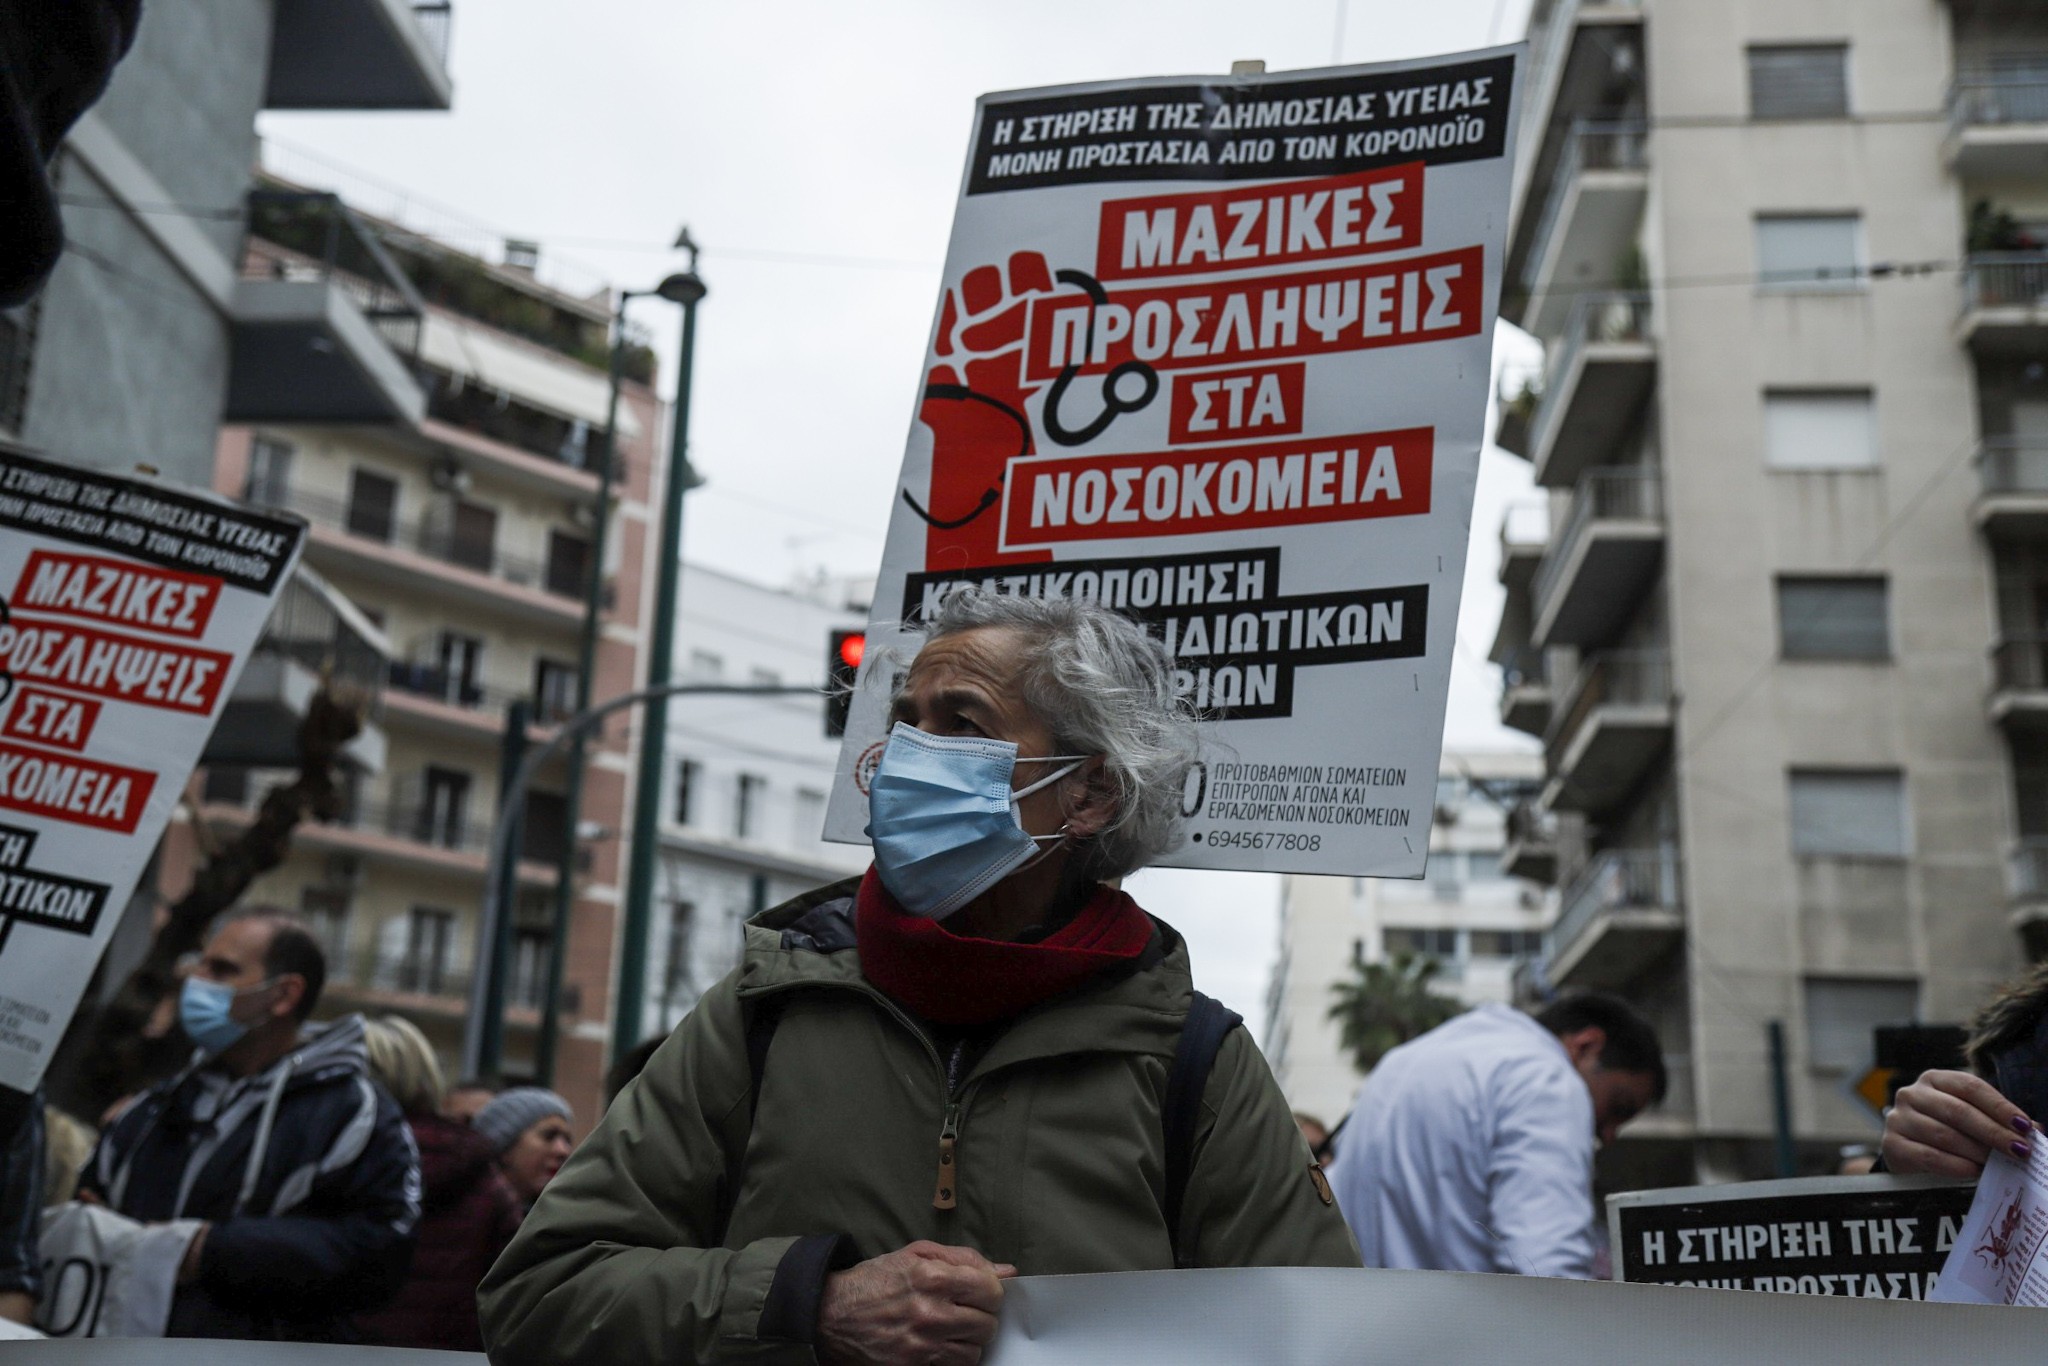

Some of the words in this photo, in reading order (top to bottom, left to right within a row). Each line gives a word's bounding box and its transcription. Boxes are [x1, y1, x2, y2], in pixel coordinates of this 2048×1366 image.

[992, 117, 1014, 145] Η
[1021, 104, 1138, 143] ΣΤΗΡΙΞΗ
[1146, 103, 1203, 131] ΤΗΣ
[1210, 94, 1375, 131] ΔΗΜΟΣΙΑΣ
[1384, 77, 1494, 117] ΥΓΕΙΑΣ
[987, 150, 1061, 178] ΜΟΝΗ
[1067, 140, 1210, 170] ΠΡΟΣΤΑΣΙΑ
[1217, 138, 1276, 165] ΑΠΟ
[1283, 134, 1338, 162] ΤΟΝ
[1344, 116, 1485, 159] ΚΟΡΟΝΟΪΟ
[1121, 179, 1405, 270] ΜΑΖΙΚΕΣ
[1049, 263, 1462, 369] ΠΡΟΣΛΗΨΕΙΣ
[1187, 373, 1286, 432] ΣΤΑ
[1029, 445, 1402, 529] ΝΟΣΟΚΟΜΕΙΑ
[216, 518, 287, 556] ΥΓΕΙΑΣ
[26, 560, 209, 631] ΜΑΖΙΚΕΣ
[1164, 600, 1404, 658] ΙΔΙΩΤΙΚΩΝ
[14, 694, 84, 743] ΣΤΑ
[1212, 783, 1289, 803] ΕΠΙΤΡΟΠΩΝ
[1292, 786, 1338, 804] ΑΓΩΝΑ
[1342, 788, 1365, 805] ΚΑΙ
[1214, 763, 1322, 784] ΠΡΩΤΟΒΑΘΜΙΩΝ
[1326, 766, 1407, 786] ΣΩΜΑΤΕΙΩΝ
[1208, 802, 1304, 823] ΕΡΓΑΖΟΜΕΝΩΝ
[1308, 806, 1410, 827] ΝΟΣΟΚΟΜΕΙΩΝ
[1208, 831, 1321, 851] 6945677808
[1642, 1231, 1666, 1265] Η
[1677, 1221, 1832, 1264] ΣΤΗΡΙΞΗ
[1842, 1218, 1922, 1255] ΤΗΣ
